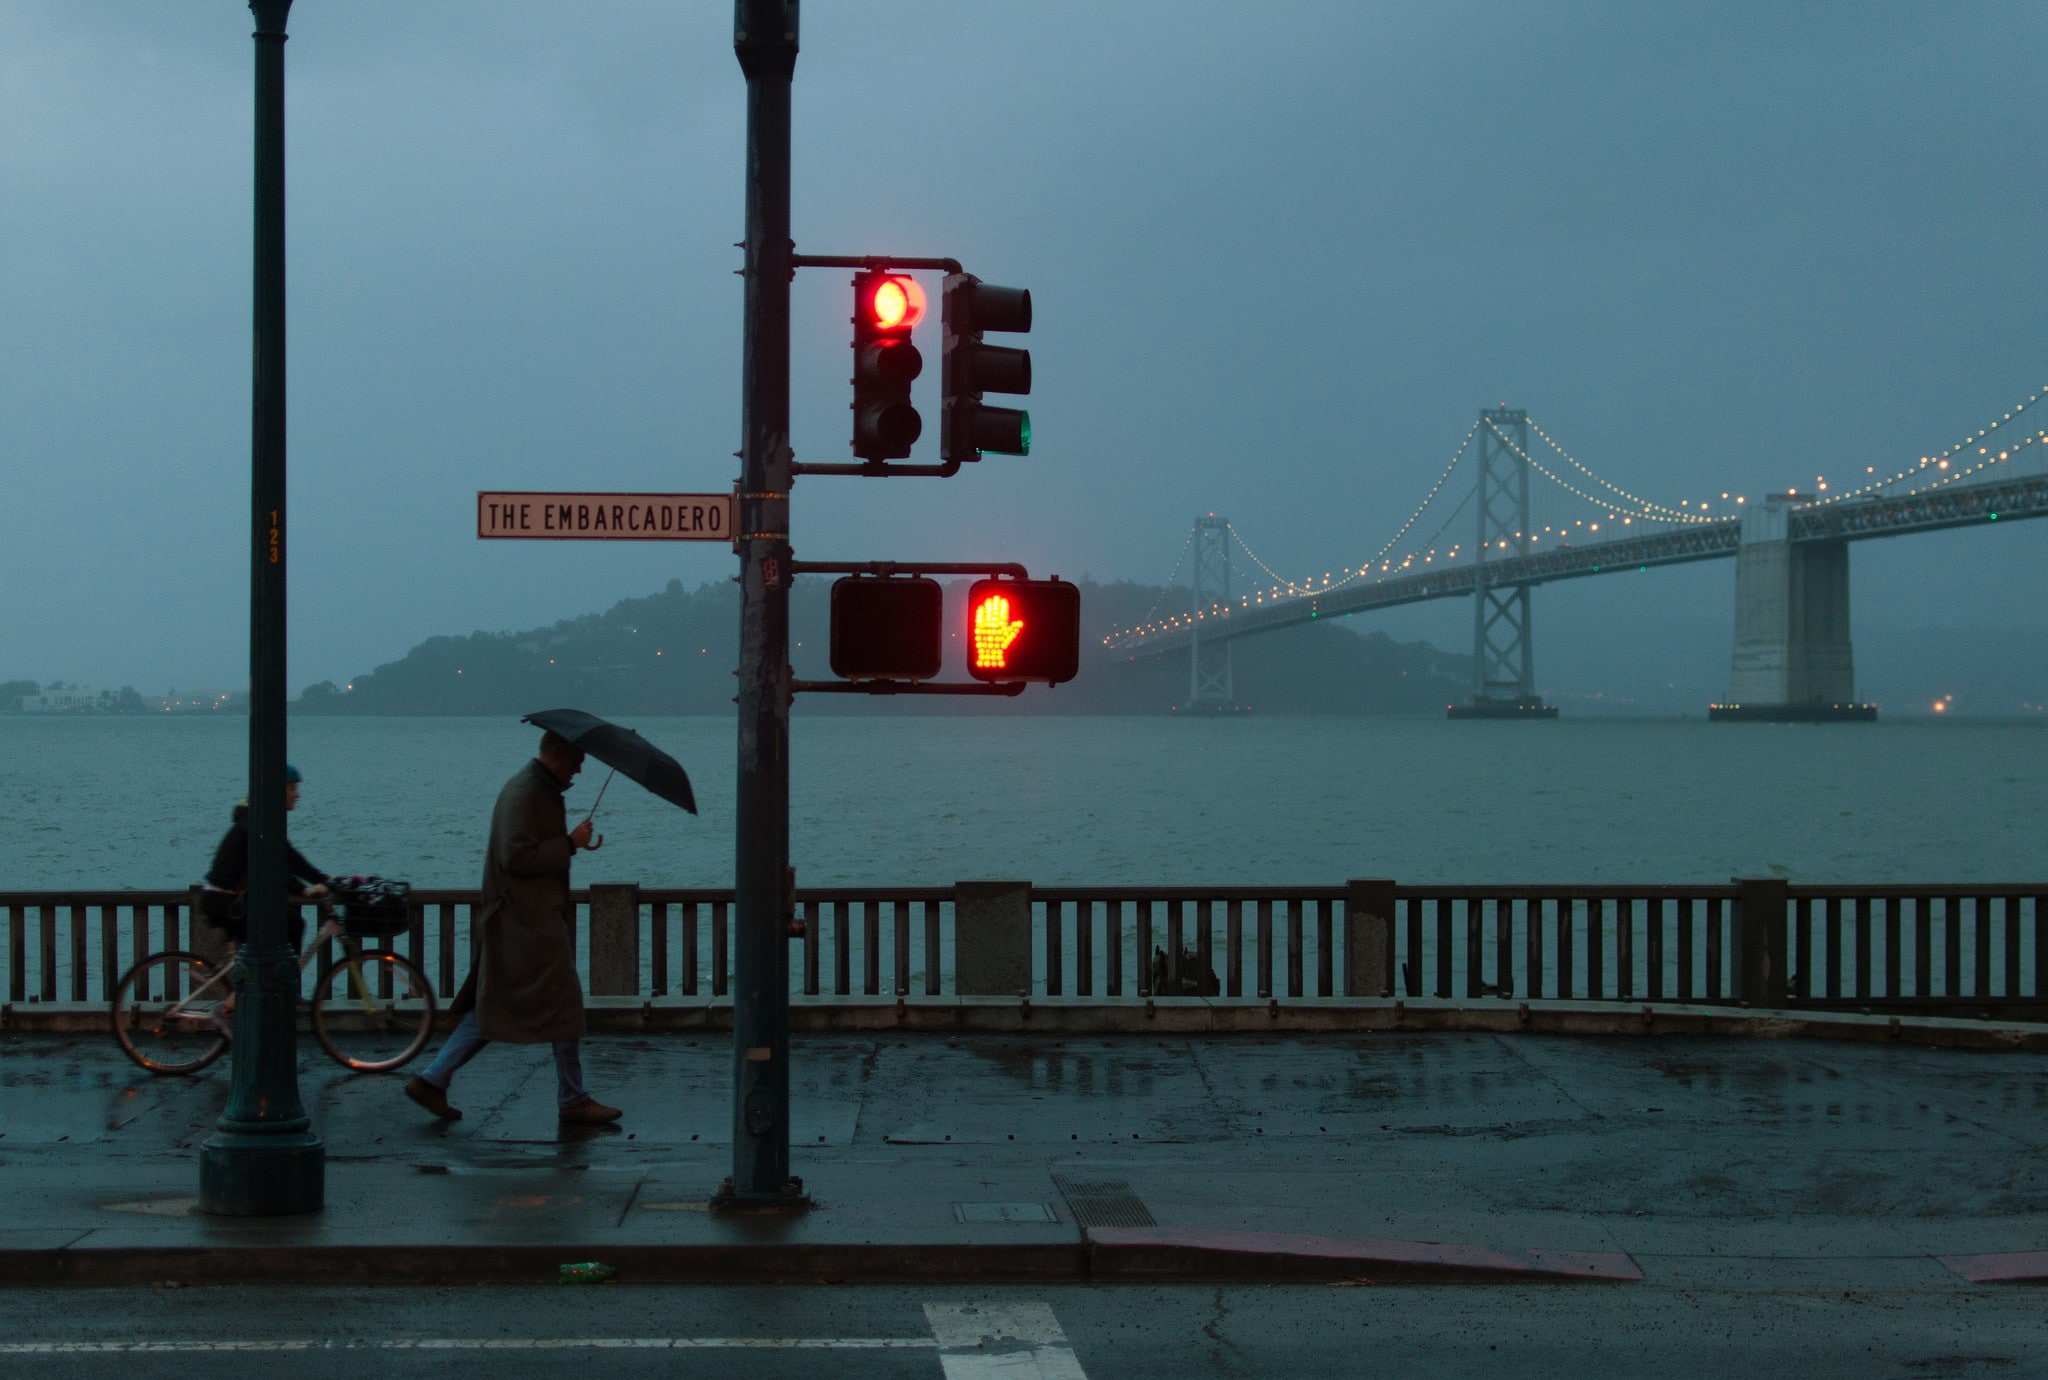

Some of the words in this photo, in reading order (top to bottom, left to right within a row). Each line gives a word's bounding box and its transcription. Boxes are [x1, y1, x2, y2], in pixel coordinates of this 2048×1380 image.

[269, 509, 279, 564] 123
[488, 504, 531, 530] THE
[544, 504, 721, 531] EMBARCADERO
